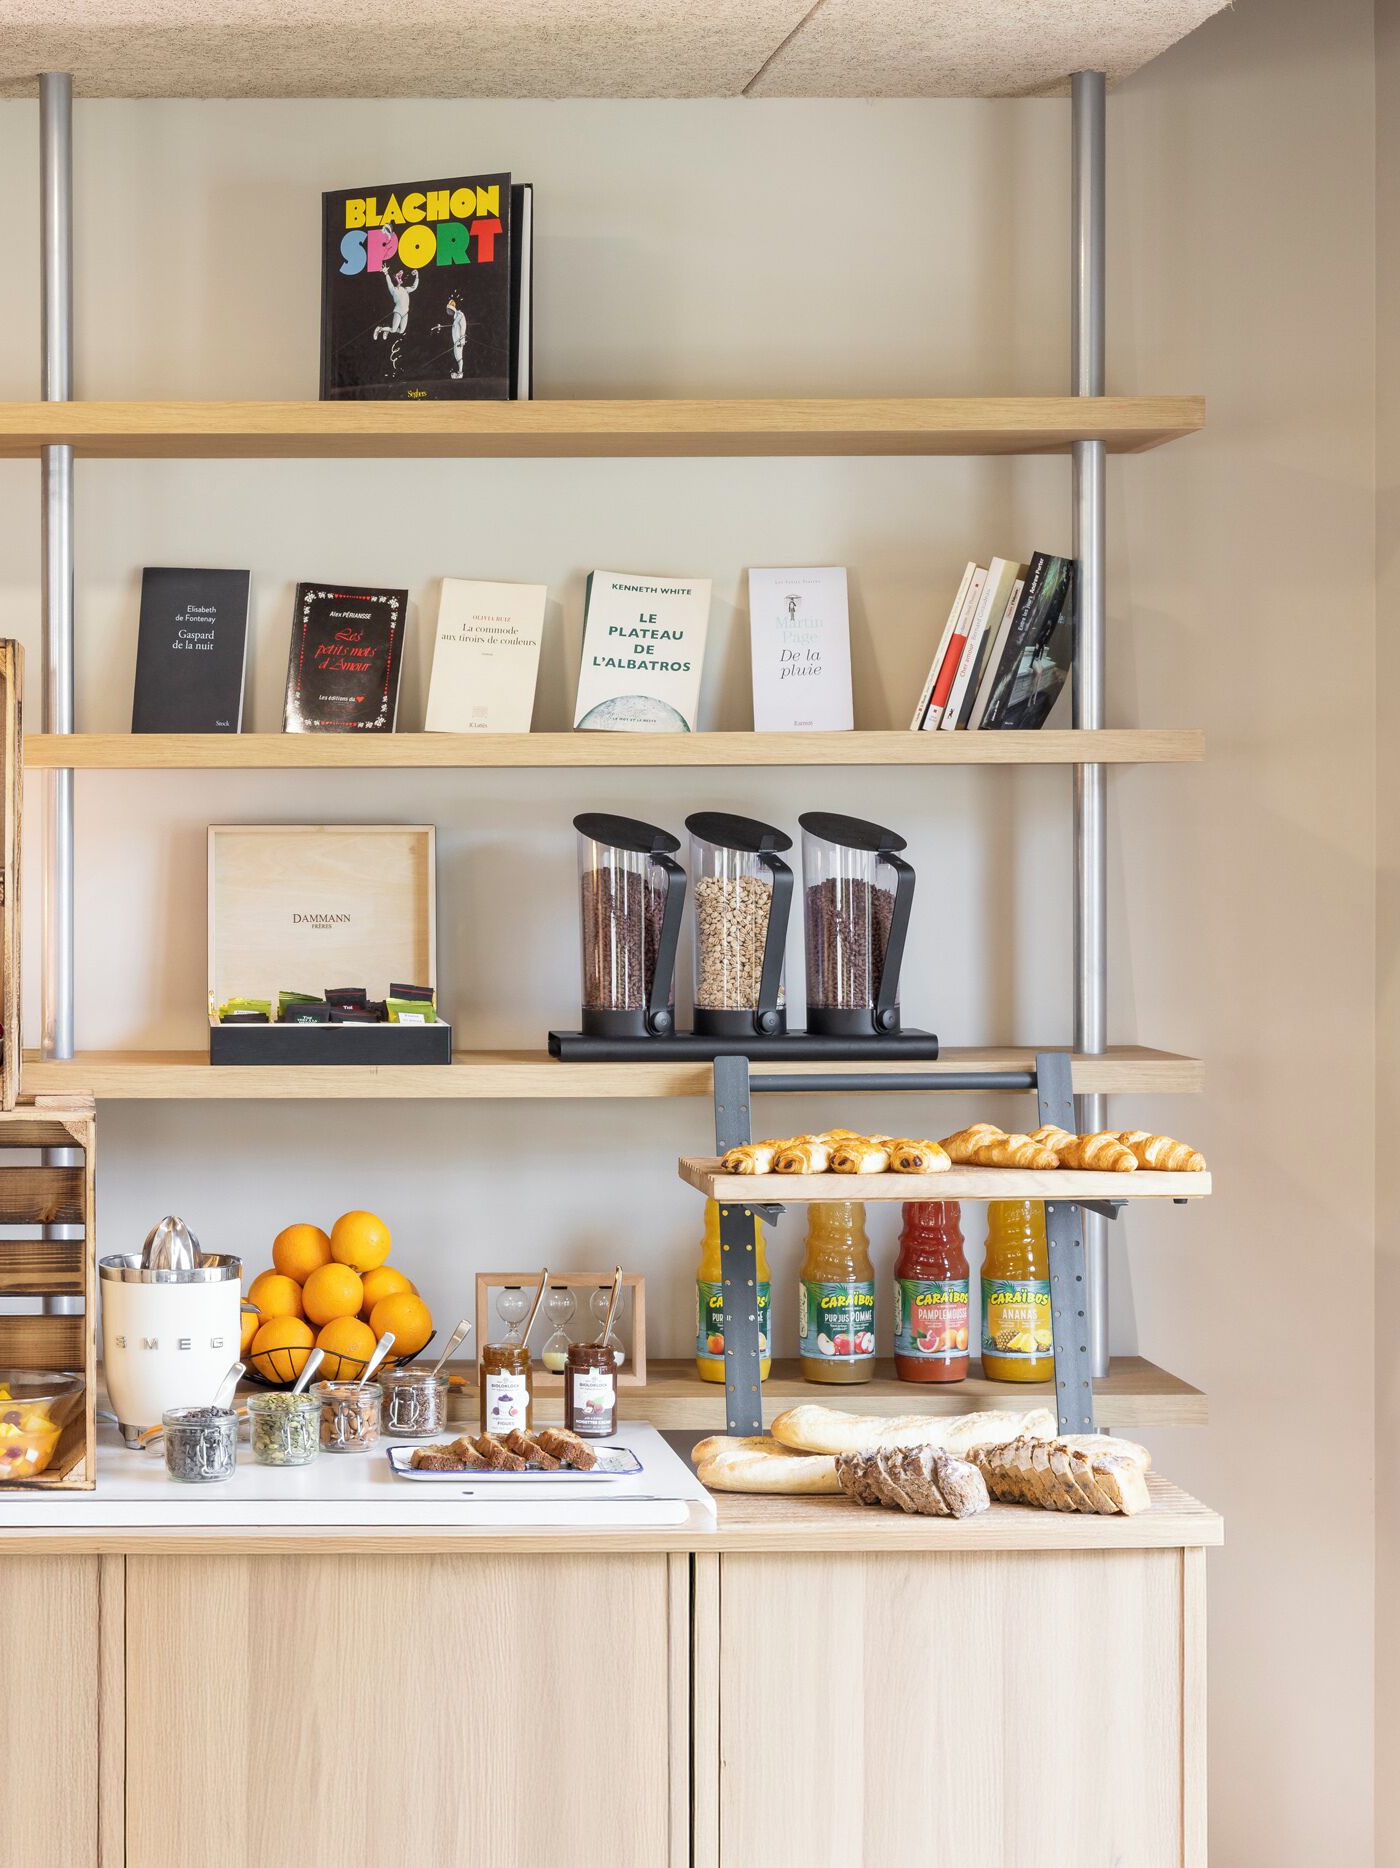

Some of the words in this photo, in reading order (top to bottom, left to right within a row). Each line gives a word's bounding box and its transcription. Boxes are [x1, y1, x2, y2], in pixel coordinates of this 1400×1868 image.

[345, 185, 500, 229] BLACHON
[339, 218, 503, 276] SPORT
[612, 583, 658, 593] KENNETH
[185, 614, 216, 624] Fontenay
[640, 613, 658, 624] LE
[776, 616, 823, 630] Martin
[178, 629, 215, 641] Gaspard
[462, 623, 473, 632] La
[475, 626, 519, 635] commode
[608, 626, 684, 640] PLATEAU
[441, 633, 456, 641] aux
[459, 634, 485, 643] tiroirs
[487, 636, 499, 644] de
[500, 637, 537, 646] couleurs
[782, 630, 818, 646] Page
[172, 640, 184, 649] de
[185, 640, 193, 649] la
[195, 641, 214, 650] nuit
[634, 644, 655, 654] DE
[780, 649, 801, 662] De
[806, 648, 820, 662] la
[593, 656, 691, 672] L'ALBATROS
[781, 664, 822, 680] pluie
[292, 913, 351, 923] DAMMANN
[821, 1291, 874, 1309] CARAÏBOS
[915, 1289, 969, 1306] CARAÏBOS
[990, 1288, 1049, 1305] CARAÏBOS
[824, 1313, 838, 1322] PUR
[838, 1313, 849, 1322] JUS
[850, 1310, 872, 1322] POMME
[918, 1307, 967, 1320] PAMPLEMOUSSE
[1002, 1308, 1038, 1320] ANANAS
